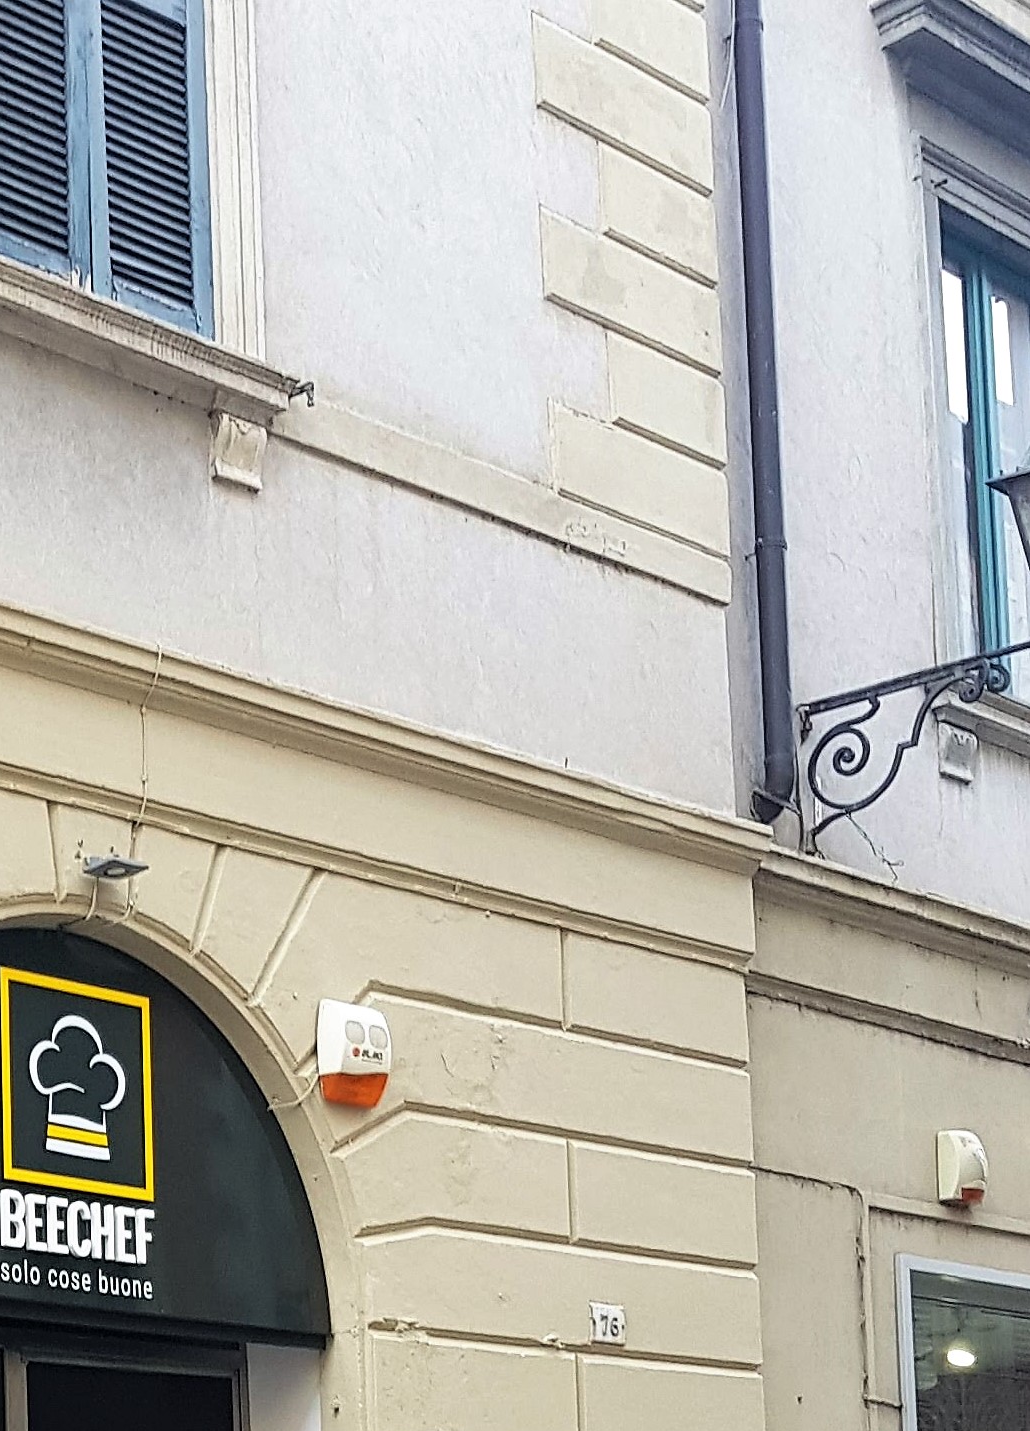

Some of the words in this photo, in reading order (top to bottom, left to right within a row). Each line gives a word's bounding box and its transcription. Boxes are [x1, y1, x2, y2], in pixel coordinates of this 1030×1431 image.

[0, 1188, 155, 1265] BEECHEF
[0, 1258, 41, 1286] solo
[47, 1267, 92, 1293] cose
[97, 1268, 154, 1300] buone
[600, 1313, 619, 1337] 76
